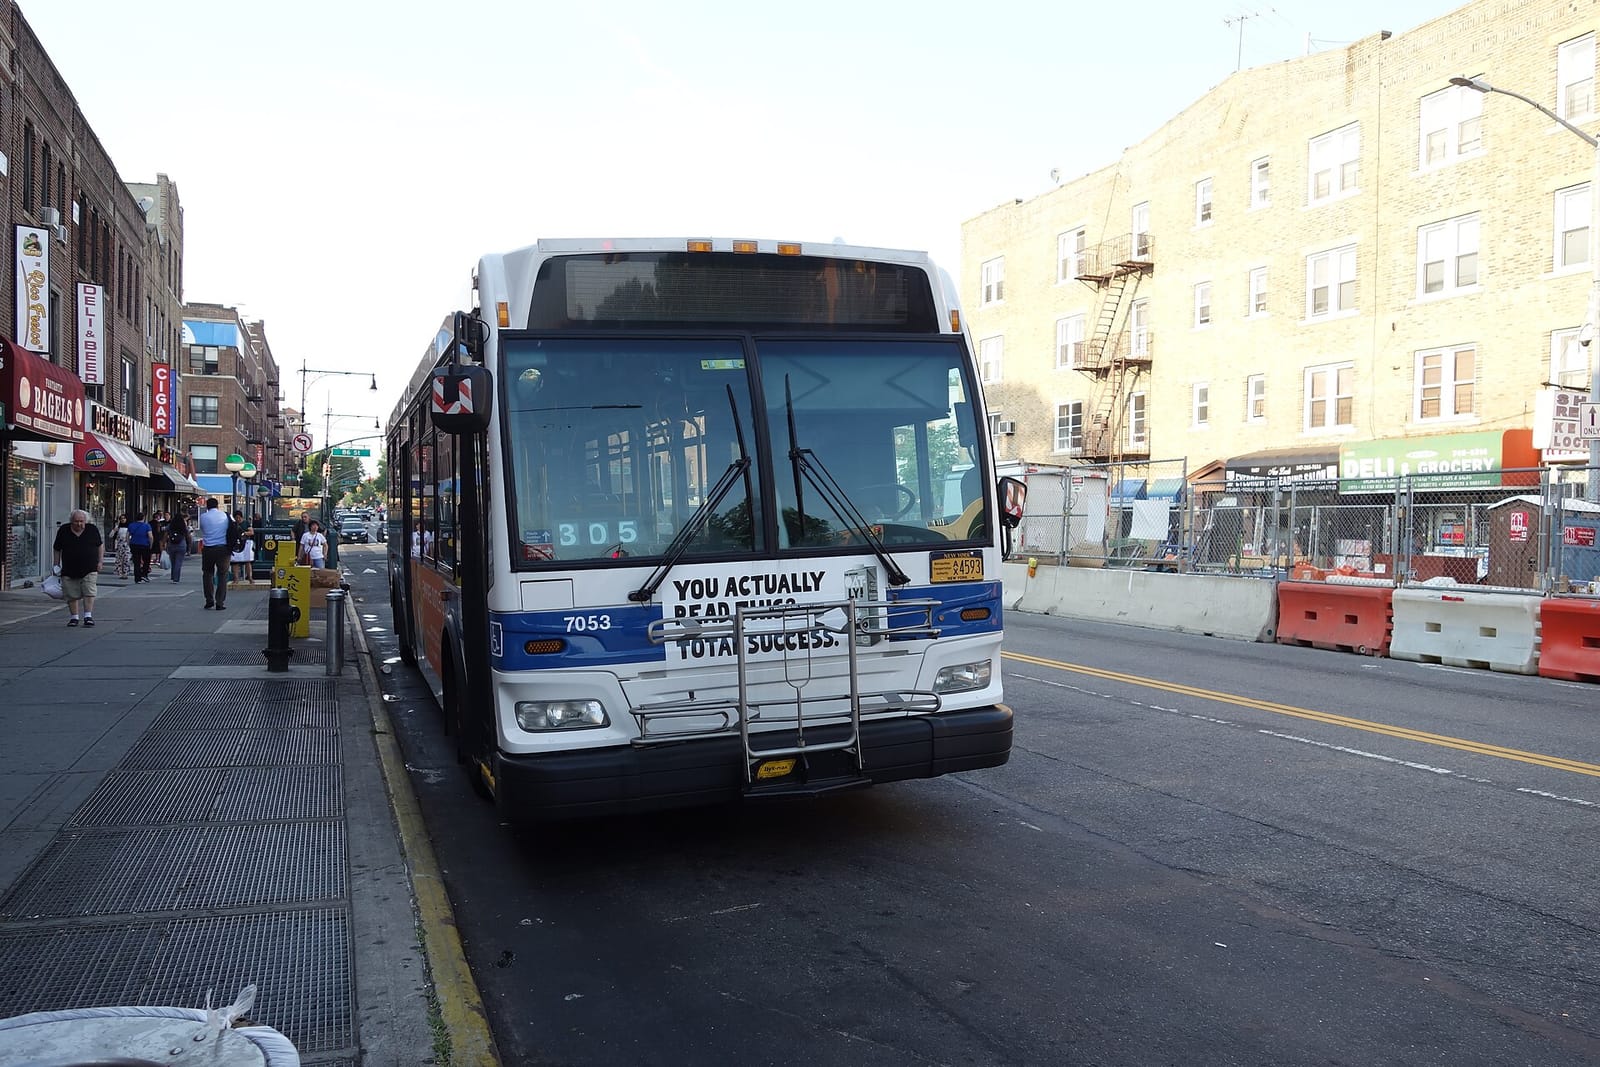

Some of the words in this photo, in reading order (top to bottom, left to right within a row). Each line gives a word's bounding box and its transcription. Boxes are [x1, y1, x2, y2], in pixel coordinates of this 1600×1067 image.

[83, 285, 97, 328] DELI
[85, 329, 95, 338] &
[84, 340, 97, 382] BEER
[34, 386, 73, 424] BAGELS
[156, 368, 167, 430] CIGAR
[1556, 394, 1587, 406] SH
[1556, 406, 1580, 417] RE
[1554, 422, 1576, 433] KE
[1583, 427, 1600, 435] ONLY
[1343, 457, 1395, 478] DELI
[1418, 457, 1495, 474] GROCERY
[559, 521, 637, 546] 305
[960, 559, 981, 575] 4593
[673, 578, 718, 600] YOU
[725, 571, 826, 597] ACTUALLY
[848, 587, 863, 599] LY!
[564, 615, 611, 633] 7053
[674, 602, 730, 625] READ
[676, 637, 740, 659] TOTAL
[747, 629, 840, 655] SUCCESS.
